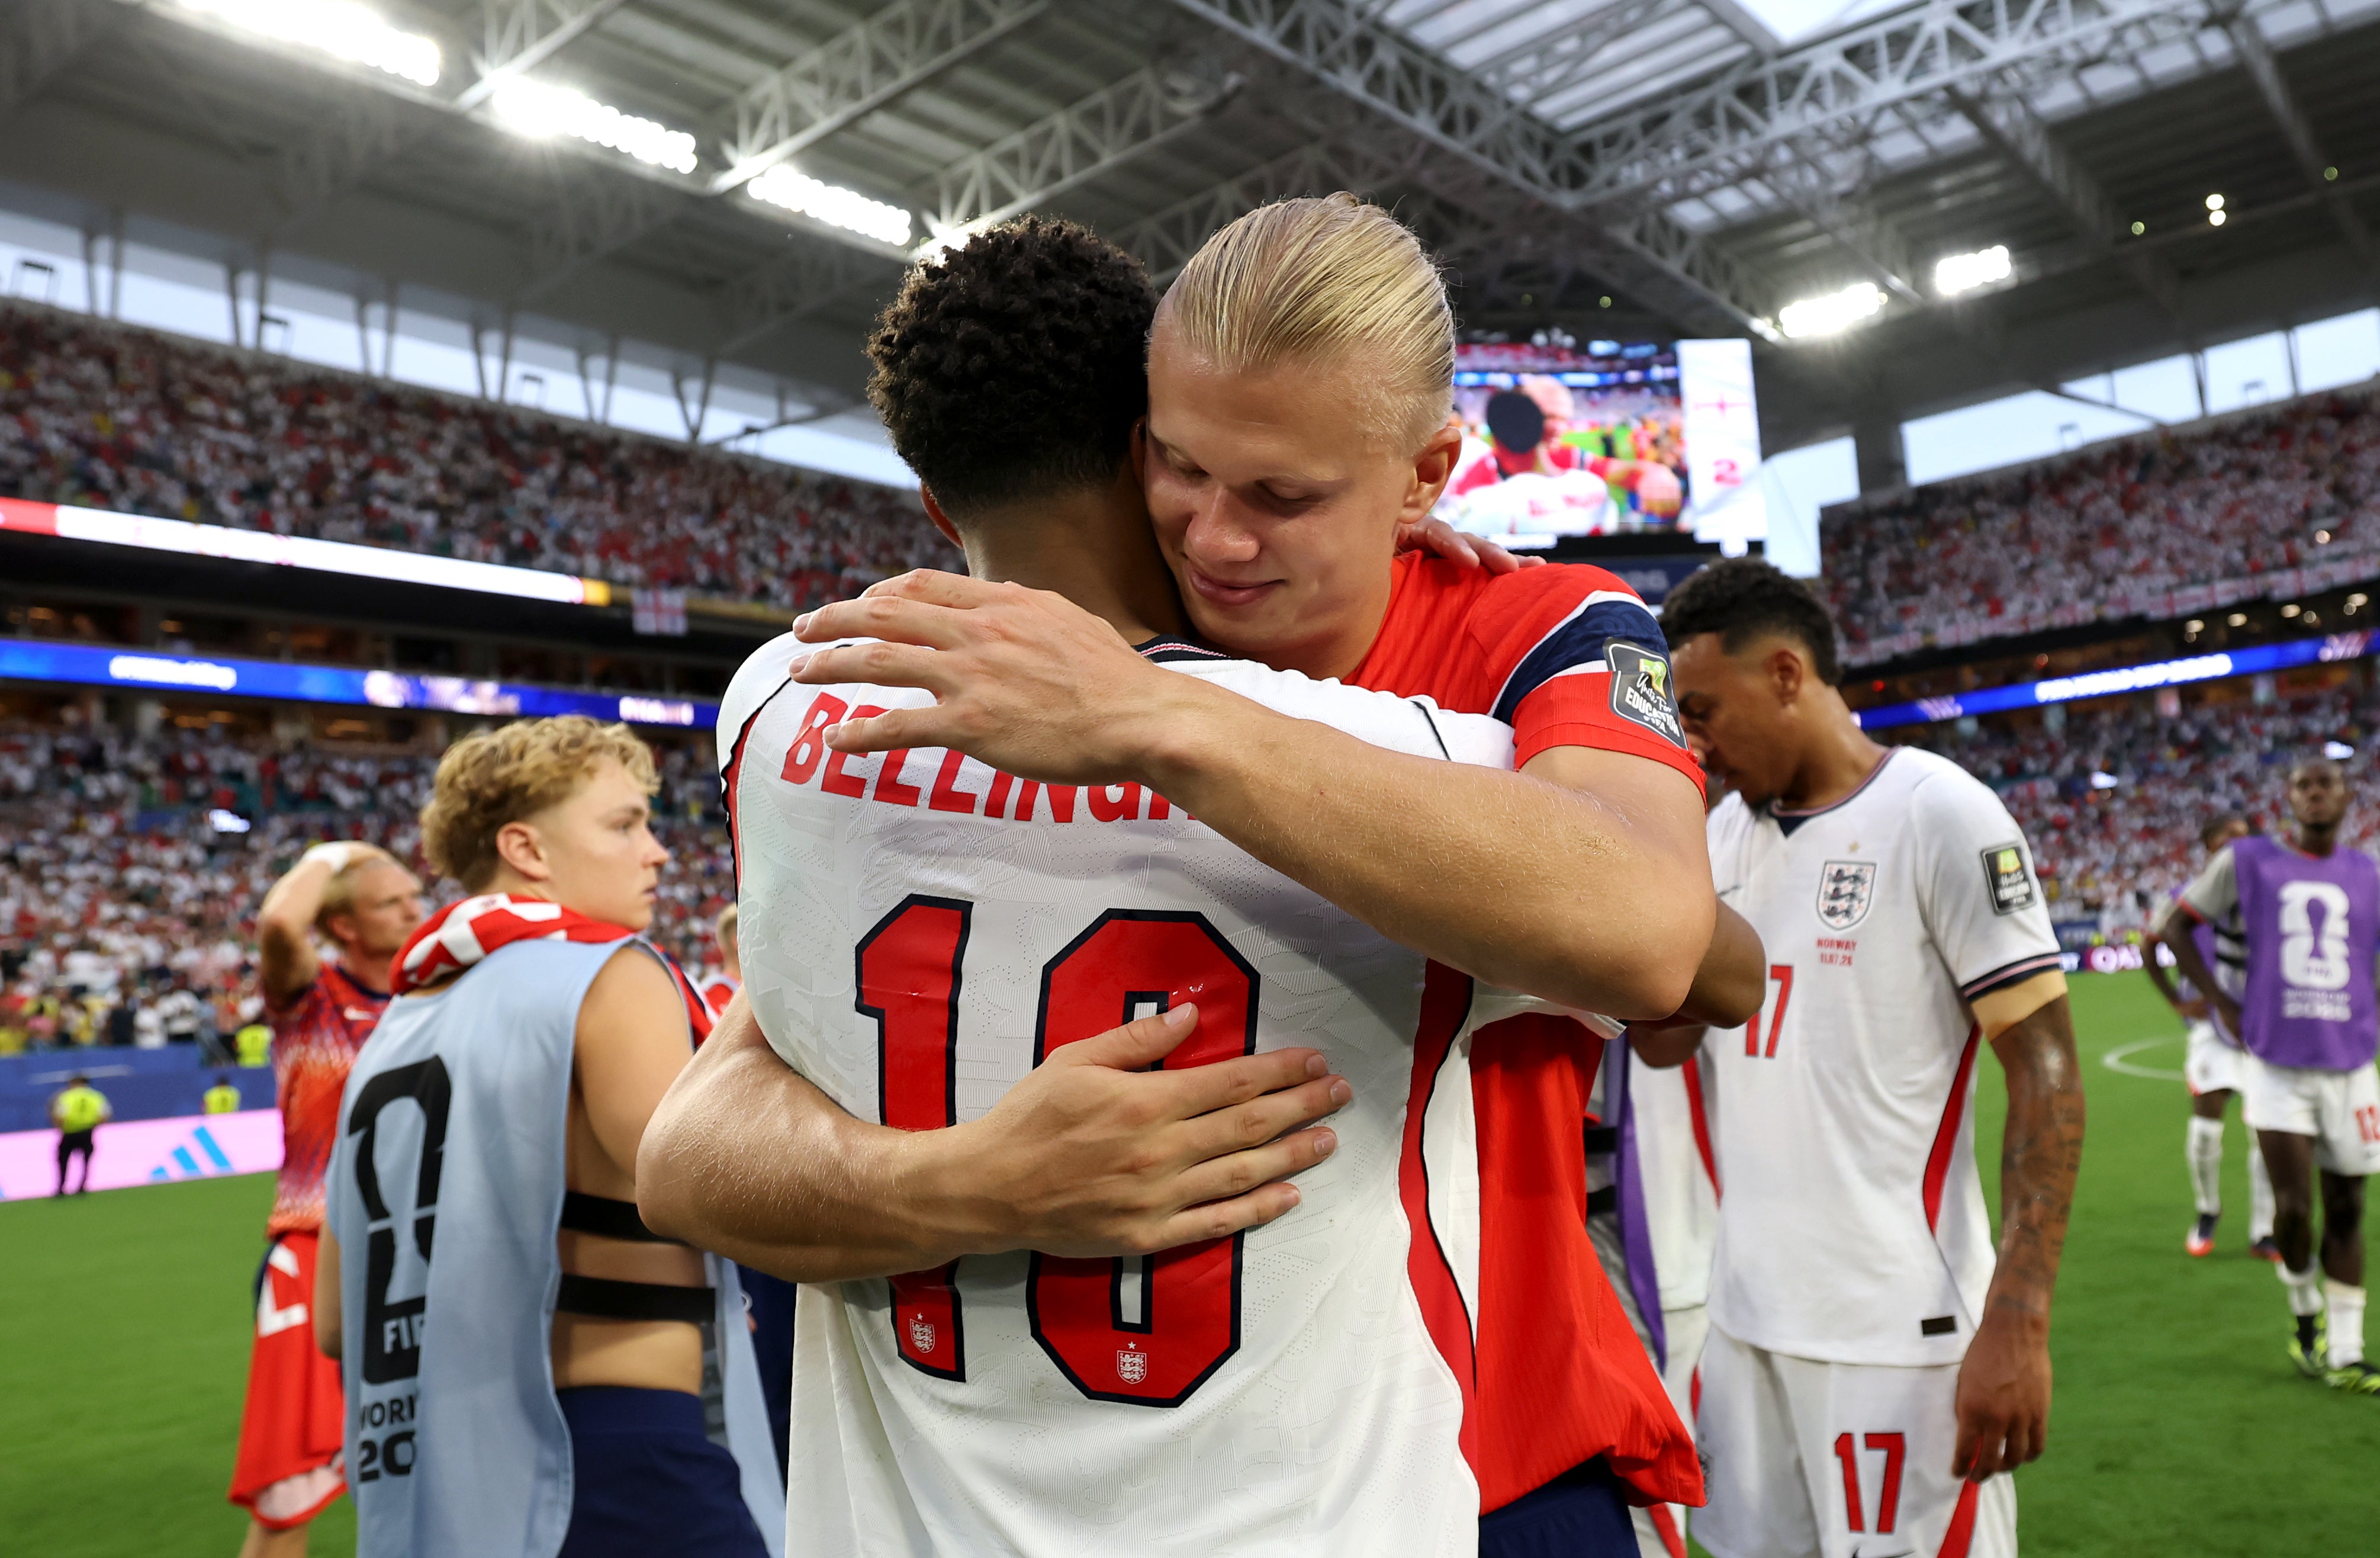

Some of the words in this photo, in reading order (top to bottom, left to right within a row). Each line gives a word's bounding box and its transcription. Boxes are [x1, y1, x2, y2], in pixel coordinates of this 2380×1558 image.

[1636, 673, 1657, 703] Unite
[1625, 686, 1681, 738] EDUCATION
[1643, 715, 1668, 734] FIFA
[1816, 938, 1857, 952] NORWAY
[855, 893, 1261, 1408] 10
[383, 1313, 424, 1354] FIF
[1835, 1432, 1906, 1534] 17
